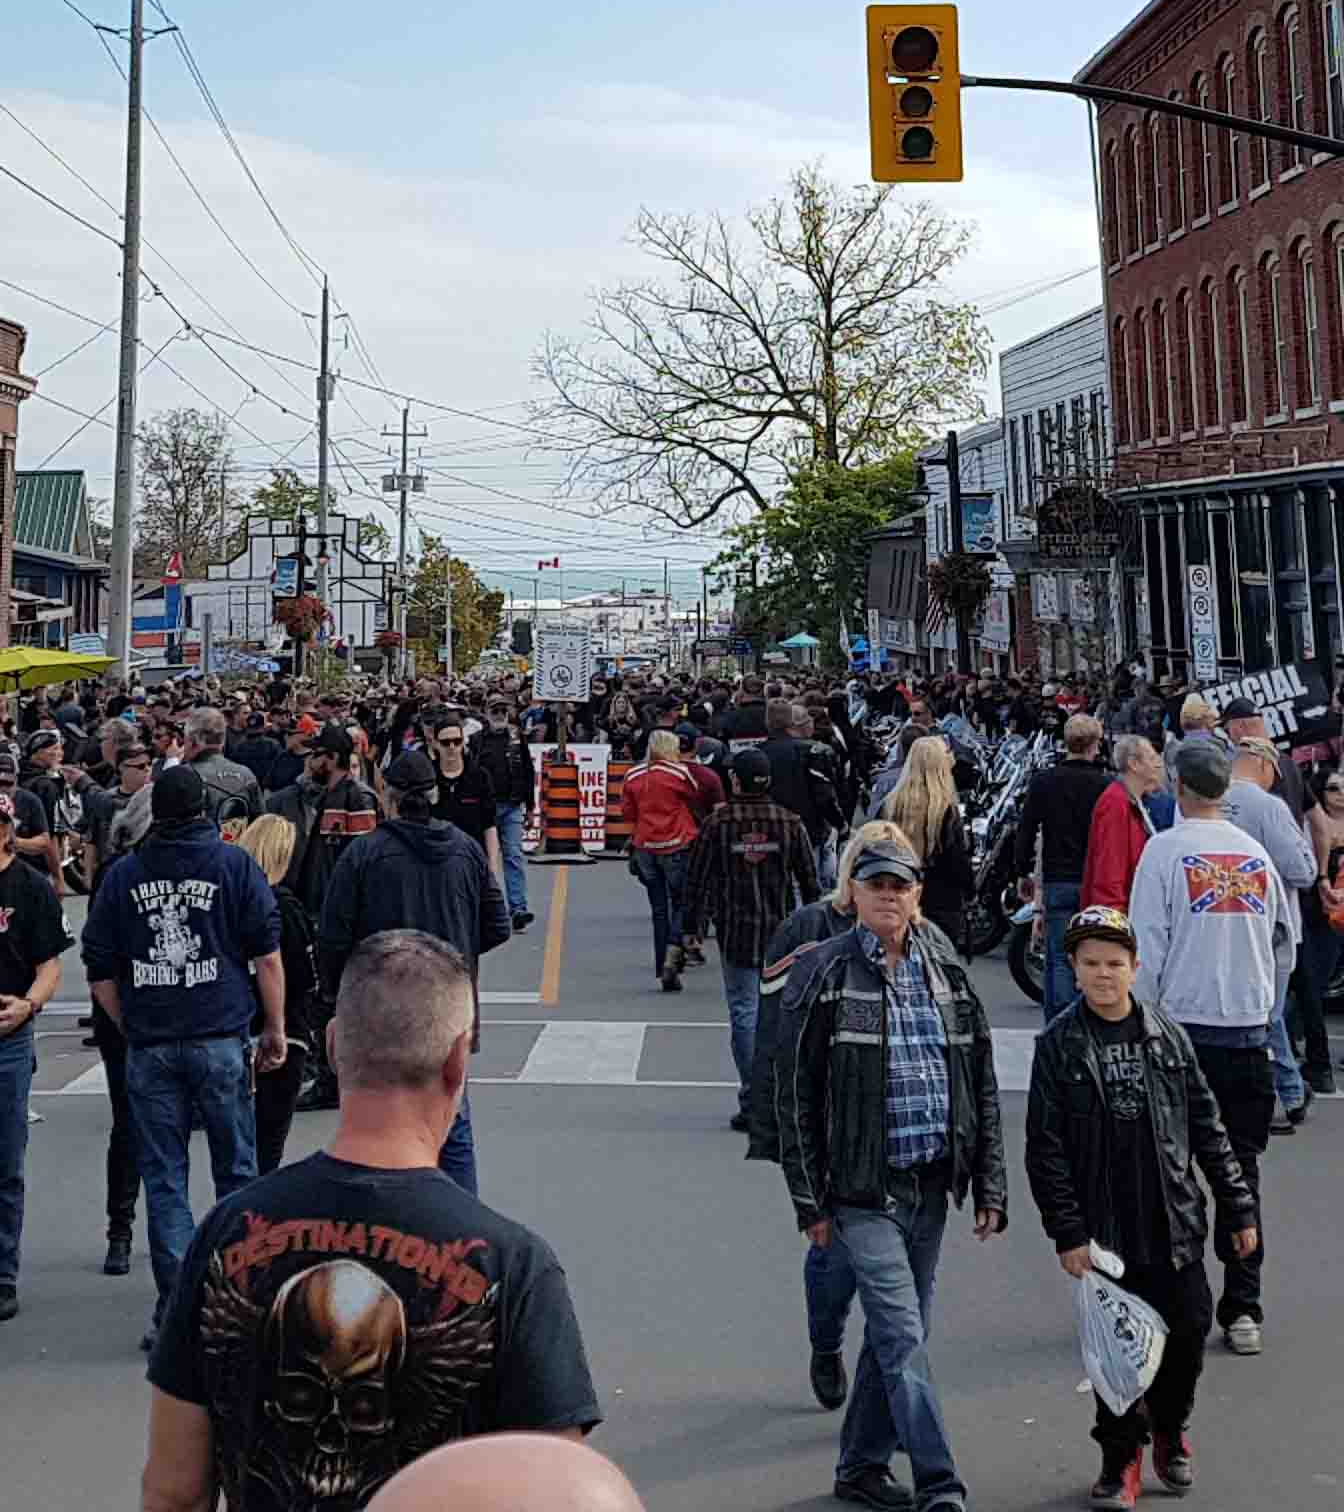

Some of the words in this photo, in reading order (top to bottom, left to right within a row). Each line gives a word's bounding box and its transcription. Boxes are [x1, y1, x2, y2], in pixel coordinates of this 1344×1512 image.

[139, 879, 175, 899] HAVE
[177, 879, 218, 899] SPENT
[184, 894, 212, 911] TIME
[132, 959, 179, 987] BEHIND
[184, 957, 217, 987] BARS
